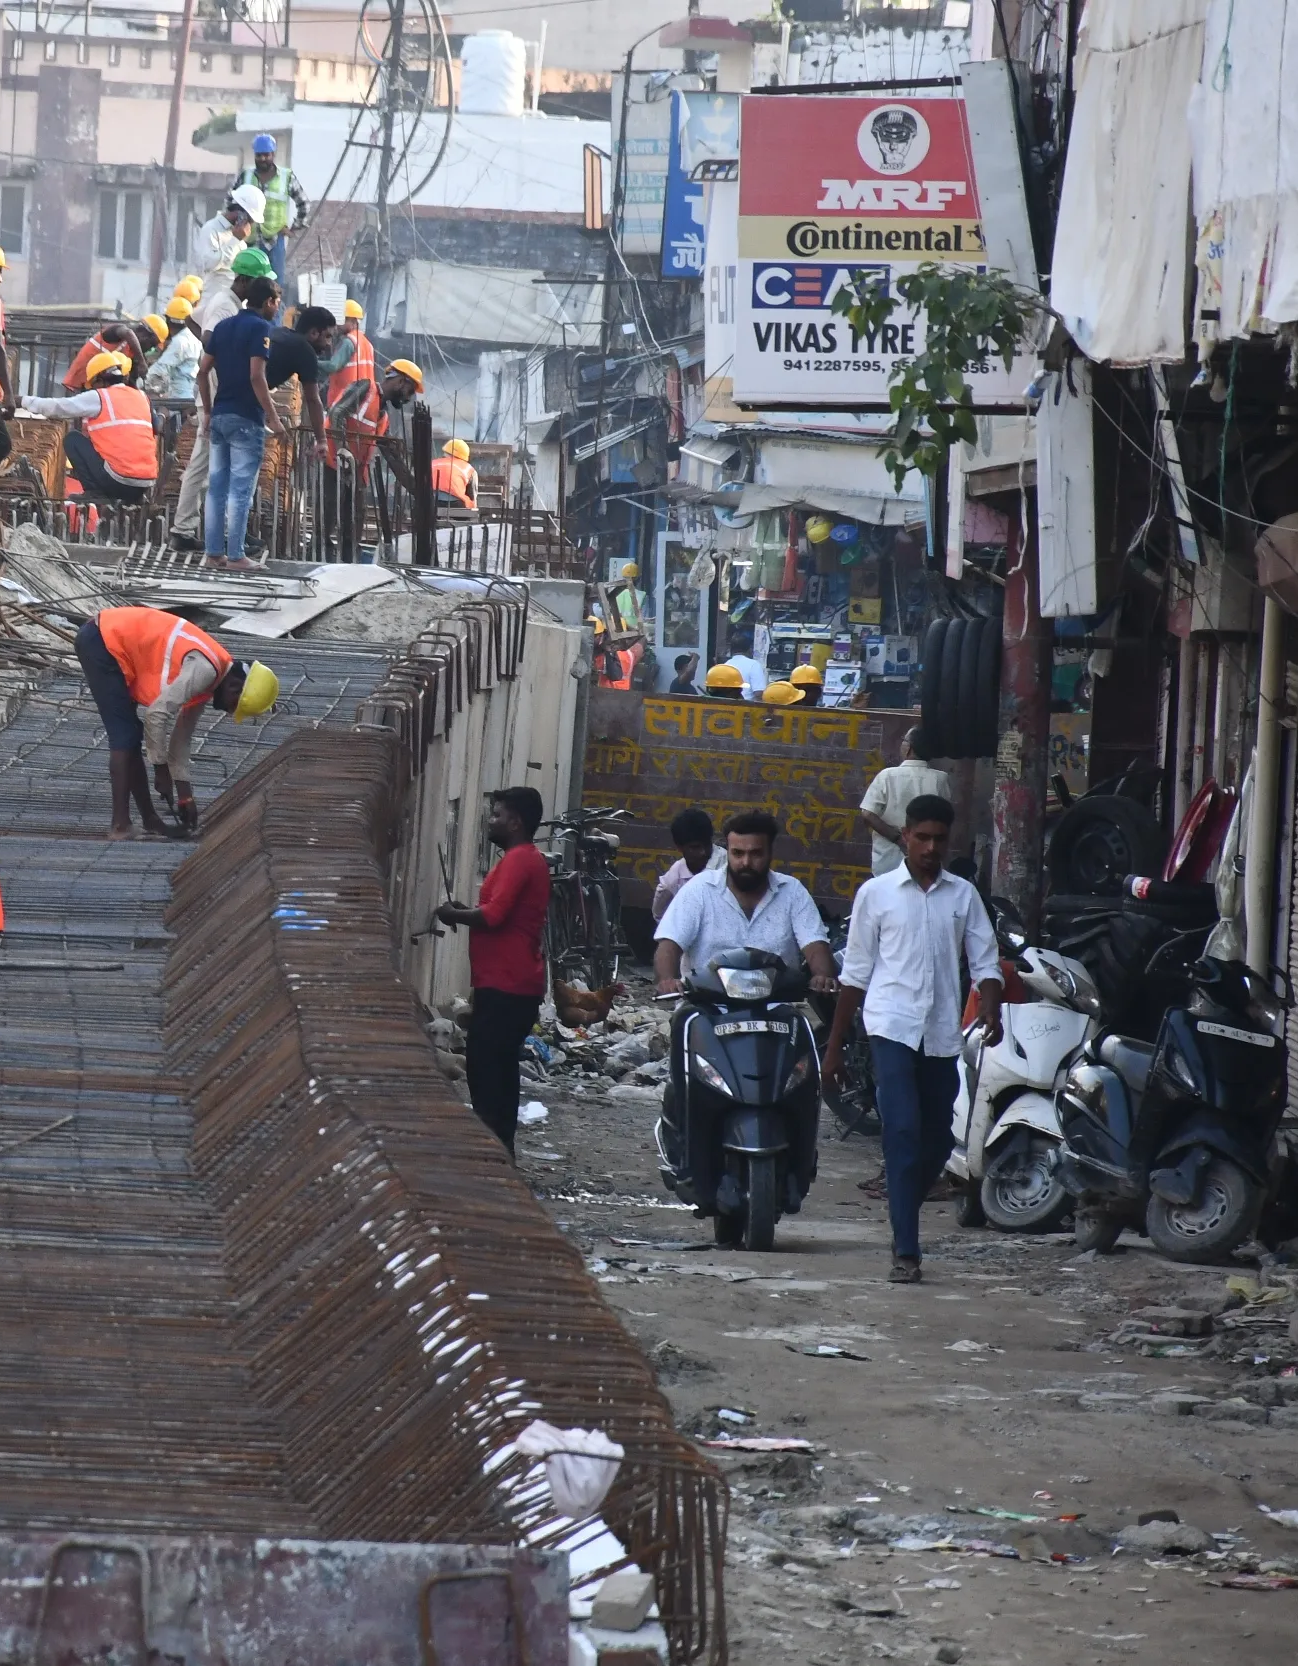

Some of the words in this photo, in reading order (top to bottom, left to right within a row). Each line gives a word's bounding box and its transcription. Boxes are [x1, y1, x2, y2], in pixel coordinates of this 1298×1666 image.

[817, 179, 966, 211] MRF
[787, 221, 963, 257] Continental
[753, 322, 837, 354] VIKAS
[848, 323, 915, 355] TYRE
[643, 698, 868, 750] सावधान
[746, 1021, 759, 1031] BK
